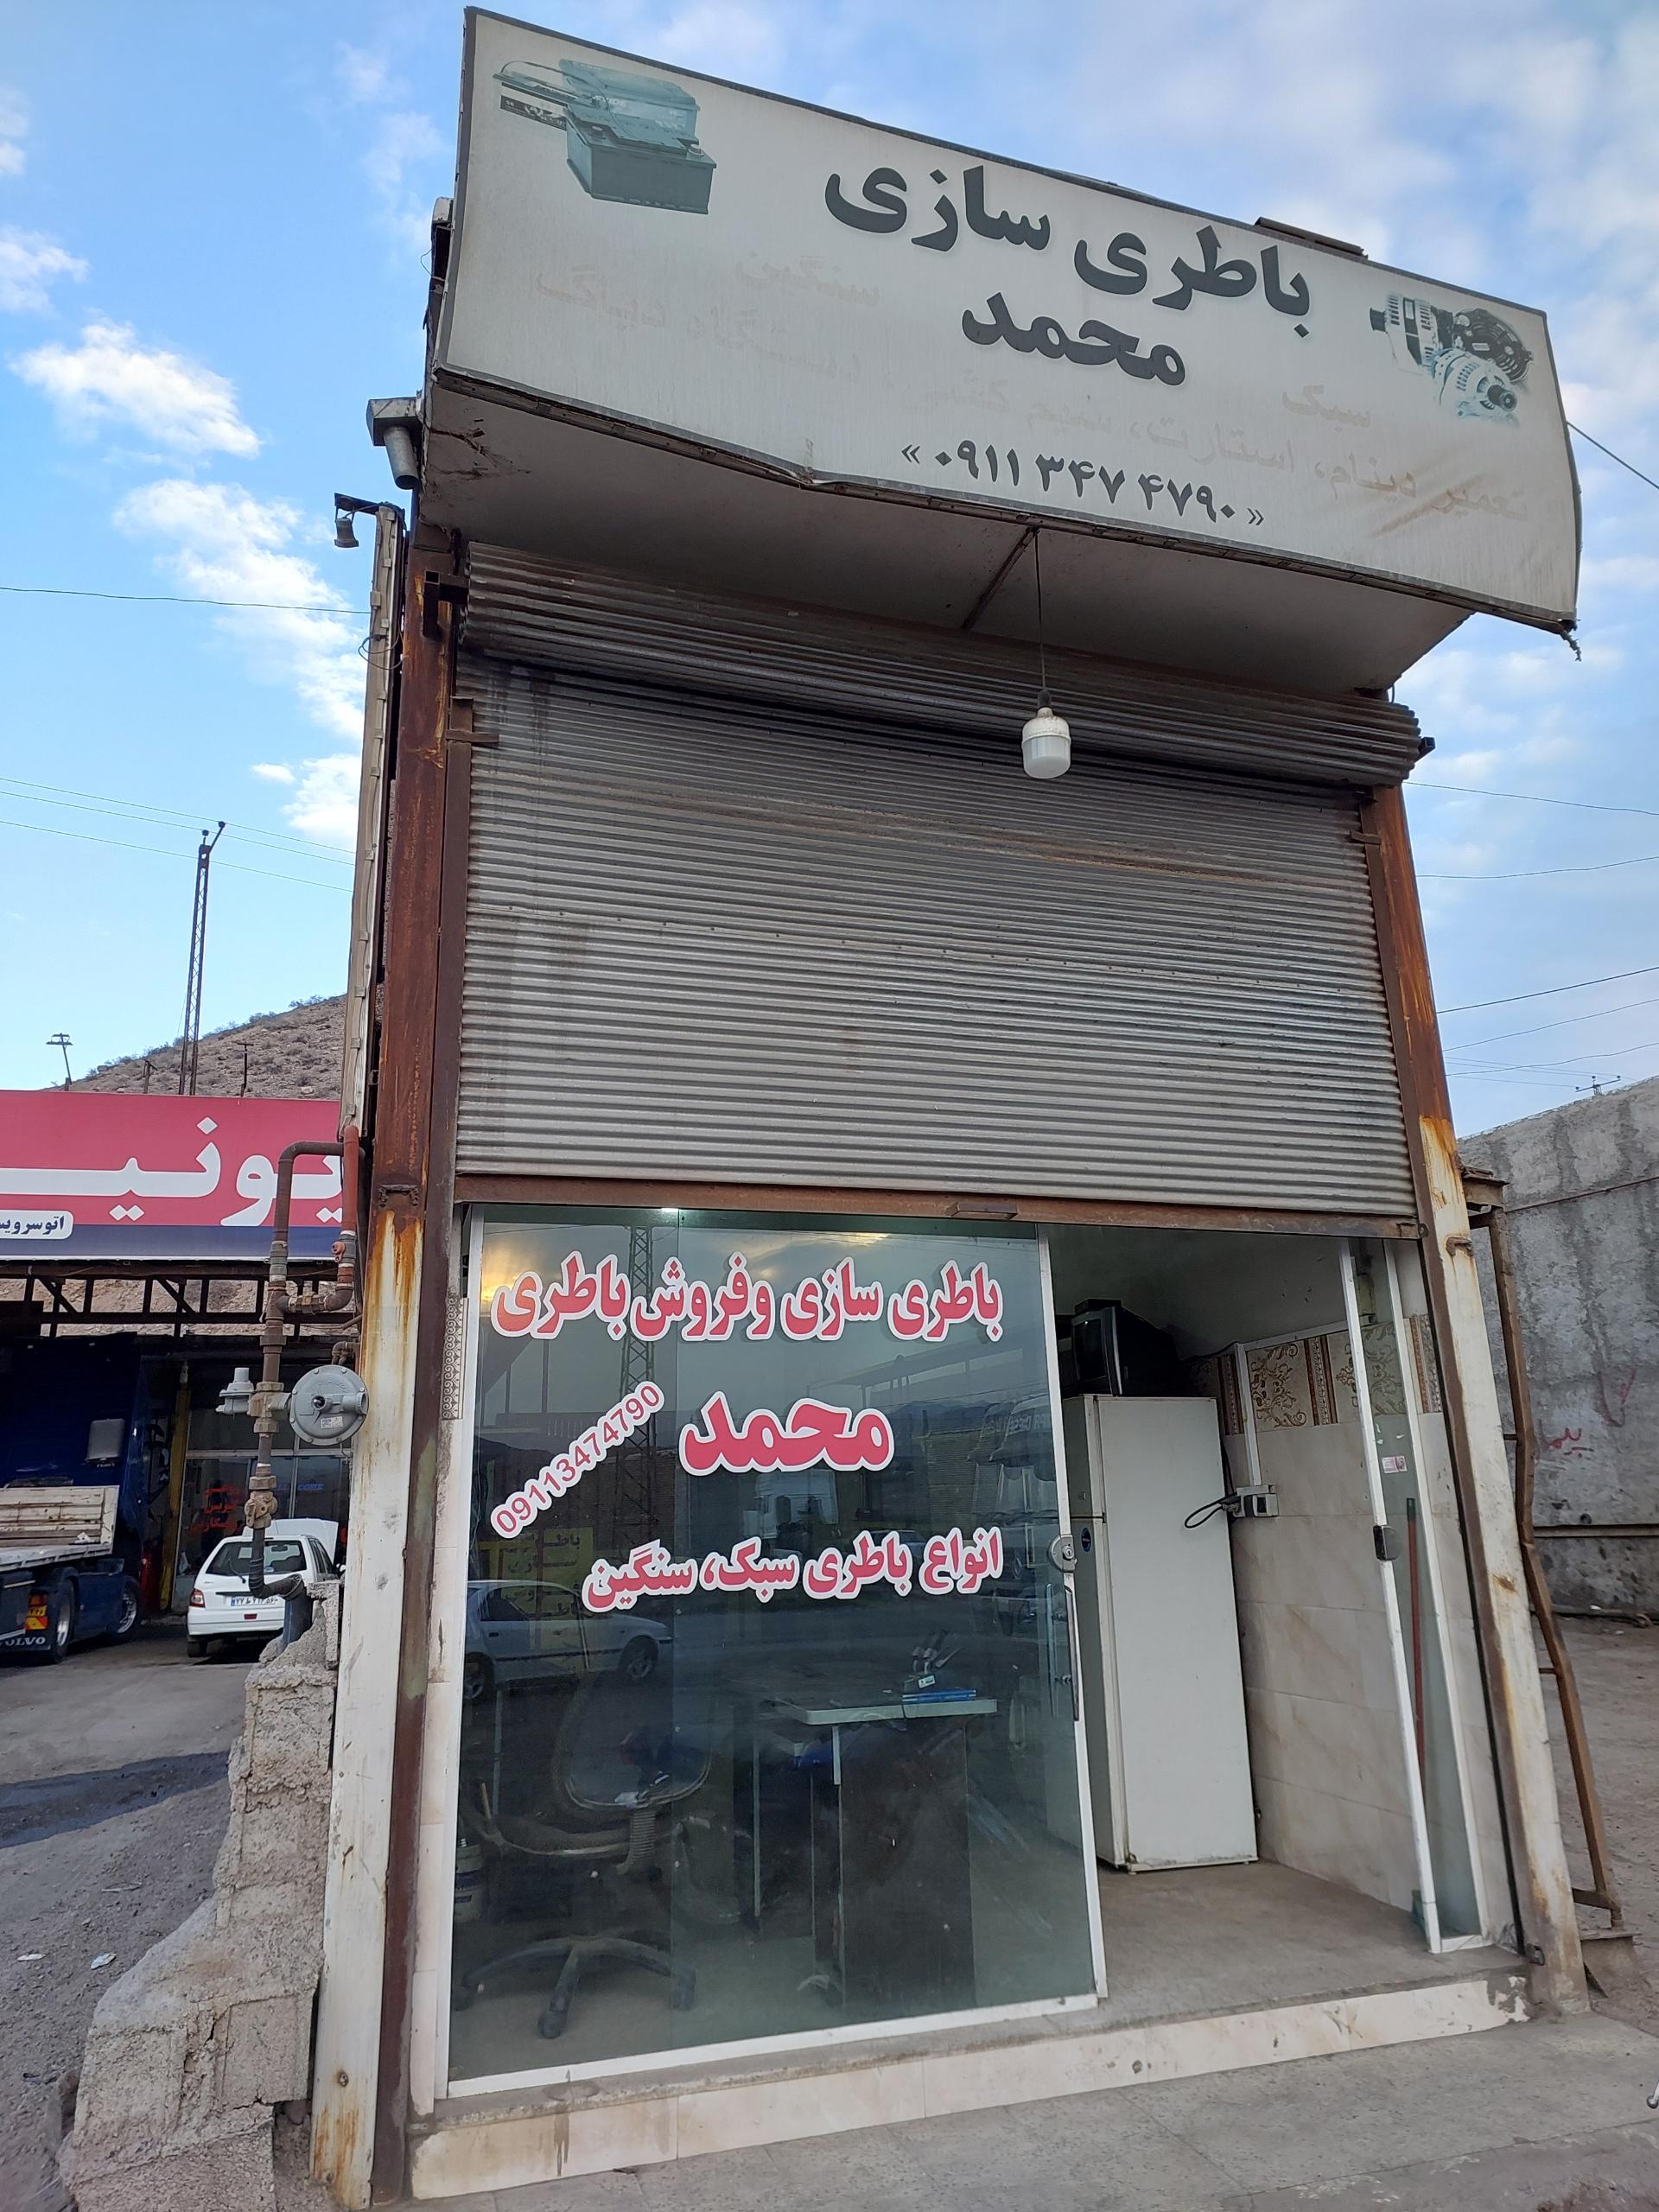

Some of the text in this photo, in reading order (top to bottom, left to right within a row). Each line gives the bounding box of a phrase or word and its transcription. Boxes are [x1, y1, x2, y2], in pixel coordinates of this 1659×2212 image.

[824, 164, 1311, 338] باطری سازی
[962, 291, 1187, 387] محمد
[1034, 453, 1127, 504] ۳۴۷
[494, 1254, 628, 1338] باطری
[783, 1259, 881, 1338] سازی
[889, 1262, 1001, 1340] باطری
[493, 1382, 662, 1535] 09113474790
[683, 1394, 892, 1471] محمد
[585, 1543, 694, 1610] سنگین
[806, 1533, 909, 1596] باطری
[922, 1529, 1001, 1592] انواع
[0, 1636, 47, 1646] OLVO
